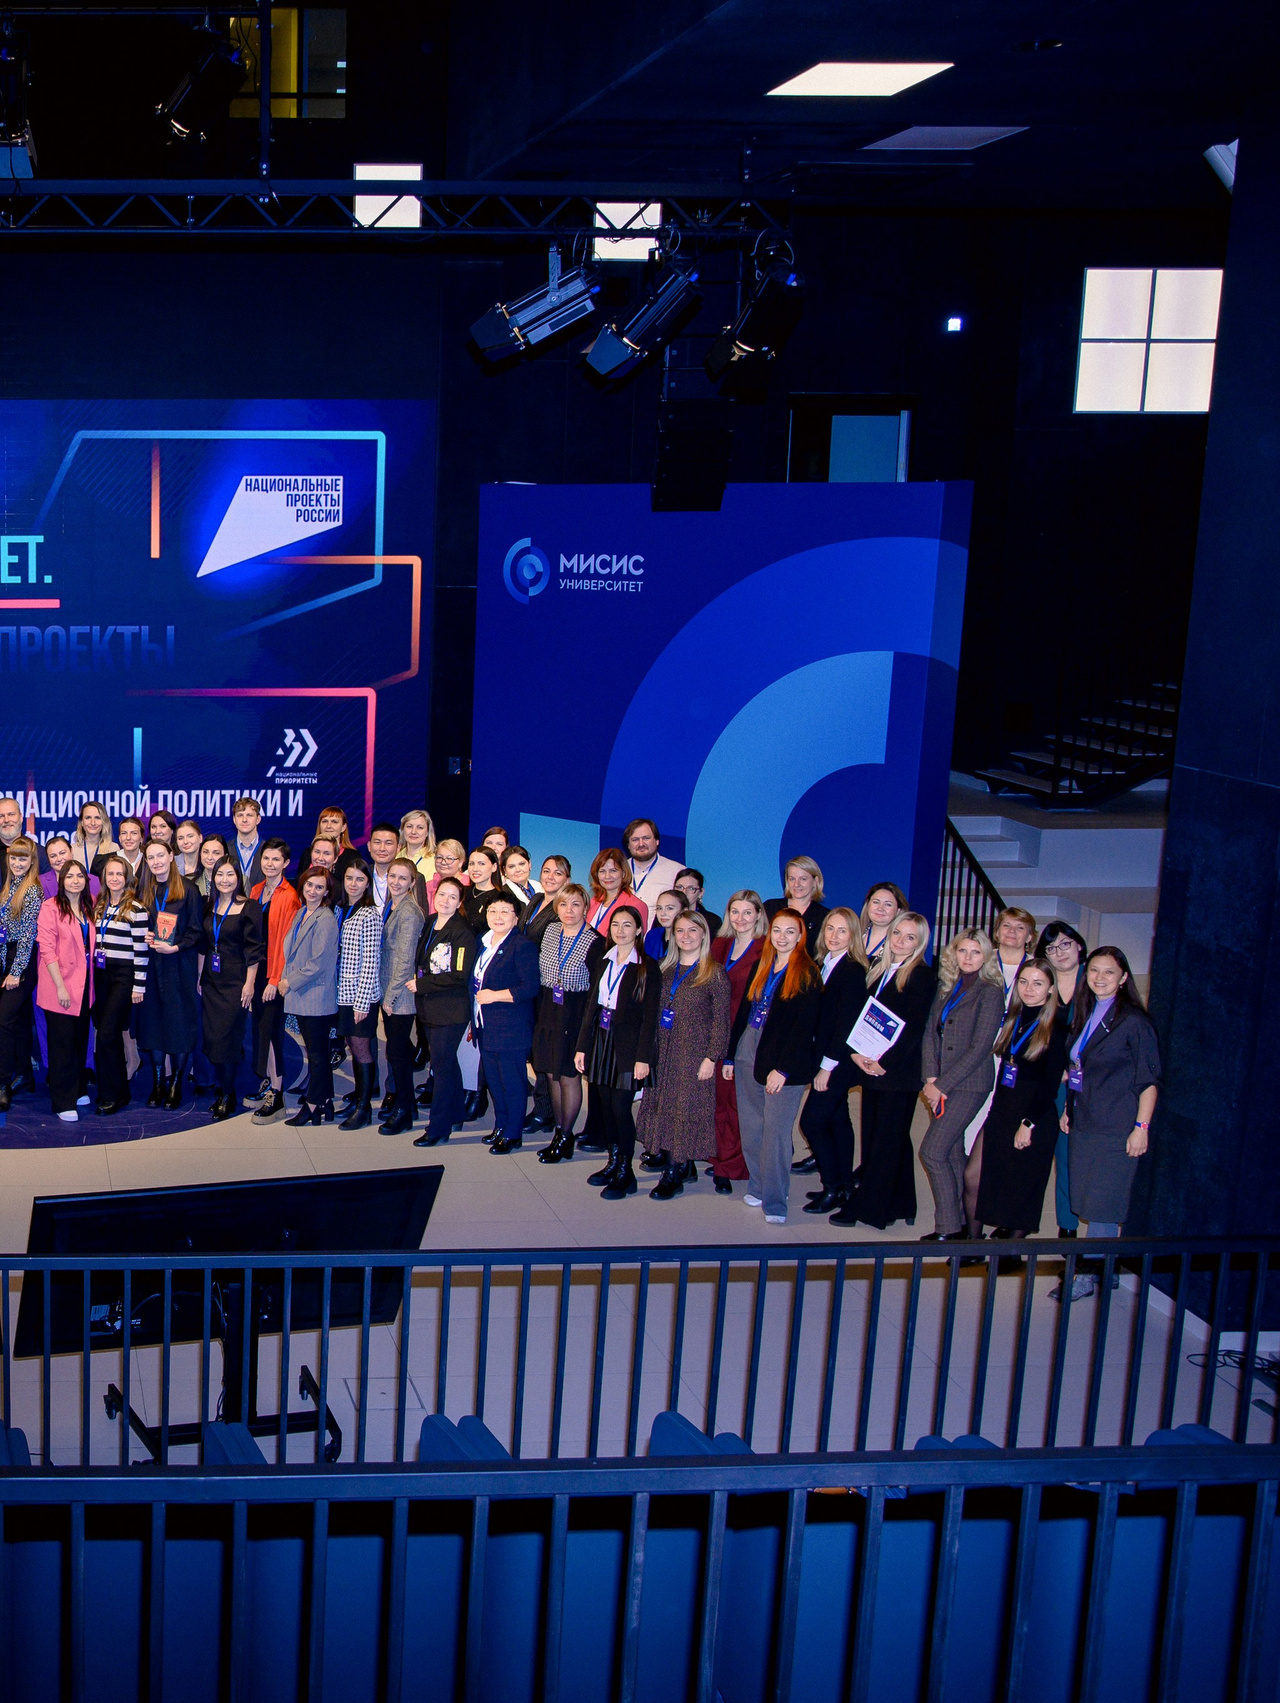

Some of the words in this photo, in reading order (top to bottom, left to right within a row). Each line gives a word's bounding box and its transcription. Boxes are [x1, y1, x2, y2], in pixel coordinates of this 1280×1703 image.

[245, 478, 341, 493] НАЦИОНАЛЬНЫЕ
[286, 493, 340, 507] ПРОЕКТЫ
[296, 508, 340, 522] РОССИИ
[559, 553, 645, 575] МИСИС
[559, 579, 643, 592] УНИВЕРСИТЕТ
[158, 790, 281, 817] ПОЛИТКИ
[288, 789, 303, 817] И
